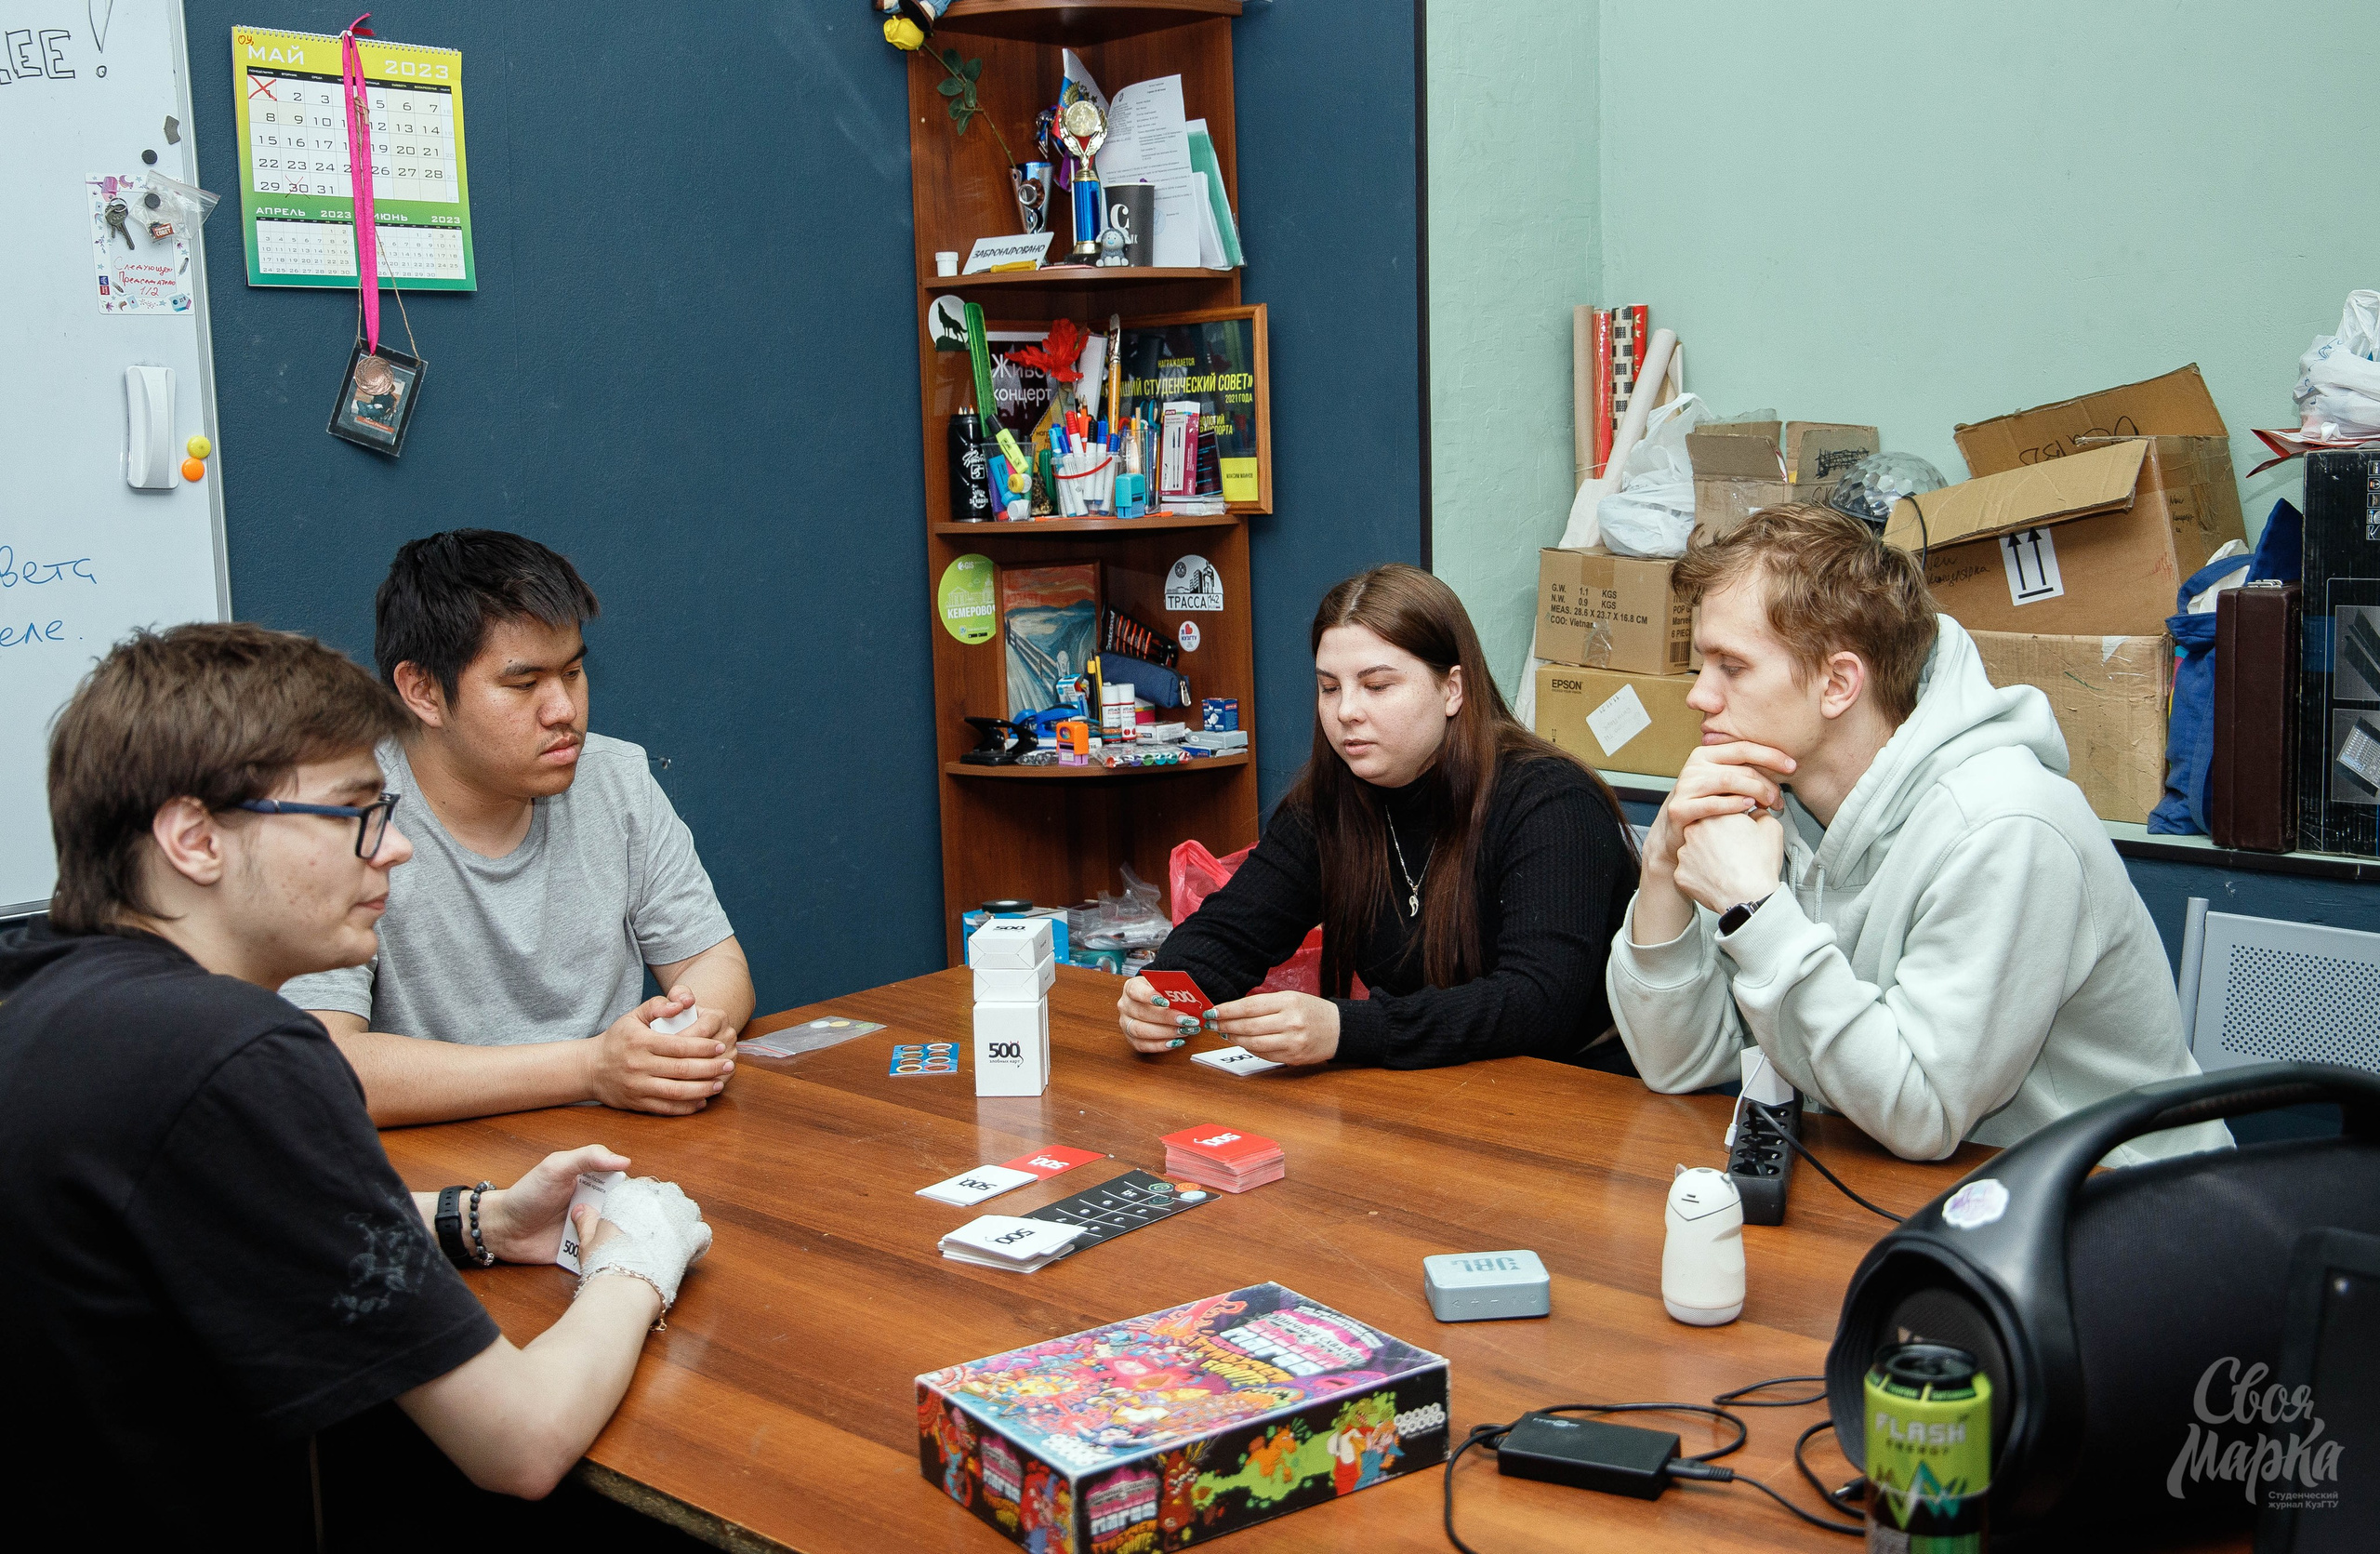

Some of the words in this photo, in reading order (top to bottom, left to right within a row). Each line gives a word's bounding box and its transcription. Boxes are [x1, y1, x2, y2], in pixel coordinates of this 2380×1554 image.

[248, 45, 304, 65] МАЙ
[385, 60, 448, 79] 2023
[293, 92, 302, 101] 2
[321, 95, 330, 104] 3
[403, 102, 411, 111] 6
[430, 104, 438, 113] 7
[266, 113, 275, 122] 8
[294, 115, 303, 125] 9
[313, 117, 332, 126] 10
[369, 122, 387, 130] 12
[396, 124, 413, 133] 13
[422, 126, 440, 135] 14
[258, 136, 277, 145] 15
[287, 138, 305, 147] 16
[315, 139, 333, 149] 17
[371, 144, 389, 153] 19
[396, 145, 415, 154] 20
[423, 147, 439, 156] 21
[258, 158, 279, 167] 22
[287, 160, 307, 169] 23
[315, 162, 335, 171] 24
[371, 166, 390, 175] 26
[398, 167, 416, 177] 27
[424, 169, 443, 179] 28
[260, 182, 280, 191] 29
[288, 182, 309, 193] 30
[317, 185, 334, 193] 31
[256, 206, 306, 217] АПРЕЛЬ
[321, 210, 351, 219] 2023
[972, 245, 1045, 259] ЗАБРОНИРОВАНО
[140, 286, 159, 296] 1/2
[1157, 357, 1196, 368] НАГРАЖДАЕТСЯ
[1144, 372, 1216, 396] СТУДЕНЧЕСКИЙ
[1218, 373, 1253, 392] СОВЕТ»
[1225, 394, 1237, 404] 2021
[1238, 393, 1253, 404] ГОДА
[1552, 584, 1566, 593] G.W.
[1580, 587, 1588, 595] 1.1
[1602, 590, 1617, 599] KGS
[1168, 596, 1207, 608] ТРАССА
[1209, 595, 1220, 604] 142
[1551, 593, 1566, 603] N.W.
[1579, 598, 1588, 606] 0.9
[1601, 601, 1616, 610] KGS
[1551, 604, 1571, 614] MEAS.
[1575, 607, 1588, 617] 28.6
[1597, 610, 1611, 619] 23.7
[1613, 613, 1618, 621] X
[1620, 614, 1634, 623] 16.8
[1636, 616, 1647, 625] CM
[1673, 605, 1685, 614] POP
[1551, 616, 1567, 625] COO:
[1552, 679, 1582, 690] EPSON
[1164, 990, 1198, 1004] 500
[988, 1041, 1021, 1058] 500
[1199, 1133, 1242, 1147] 500
[1026, 1155, 1070, 1170] 500
[958, 1177, 998, 1190] 500
[995, 1228, 1036, 1244] 500
[563, 1239, 579, 1257] 500
[1450, 1257, 1521, 1272] JBL
[1875, 1412, 1966, 1445] FLASH
